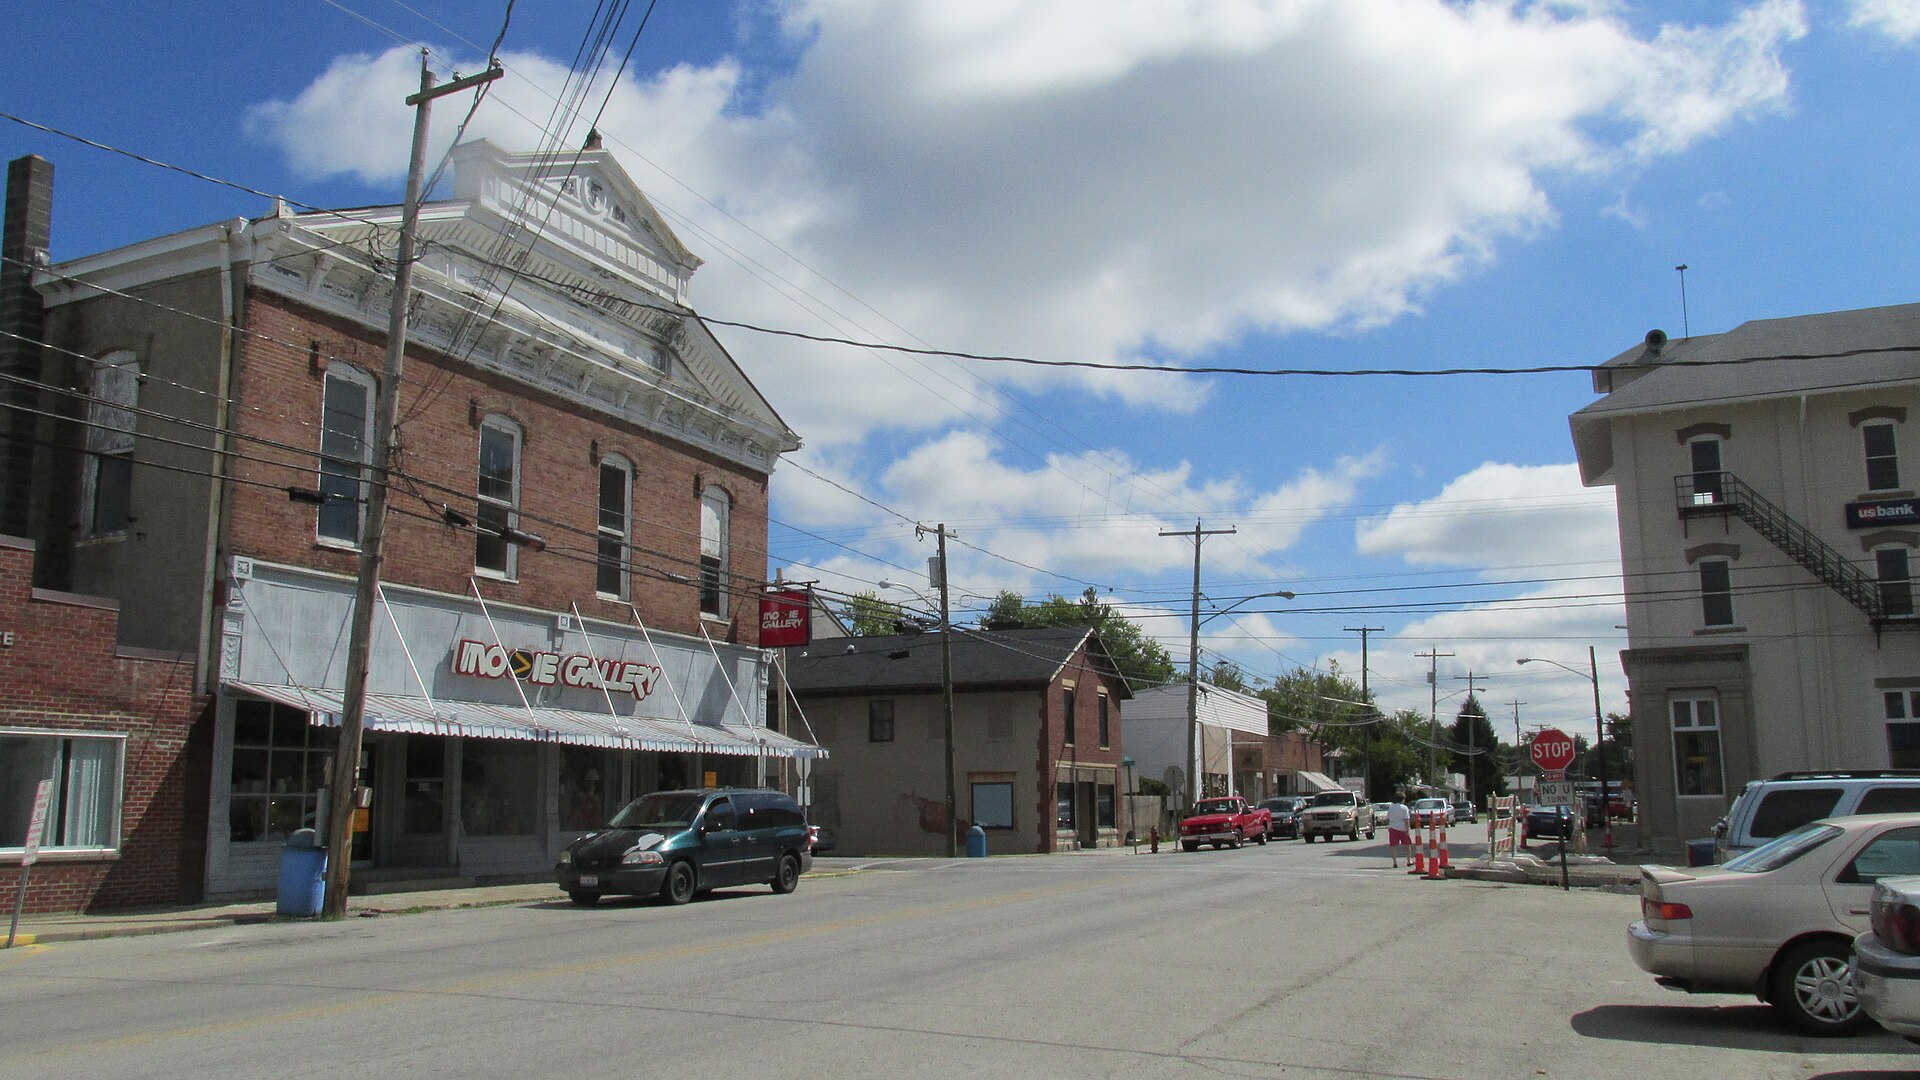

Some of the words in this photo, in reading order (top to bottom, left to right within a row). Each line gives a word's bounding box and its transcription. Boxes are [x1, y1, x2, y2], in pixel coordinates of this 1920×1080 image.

[762, 618, 803, 629] GALLERY
[564, 655, 660, 699] GALLERY
[1534, 742, 1570, 758] STOP
[1542, 785, 1556, 795] NO
[1563, 785, 1570, 794] U
